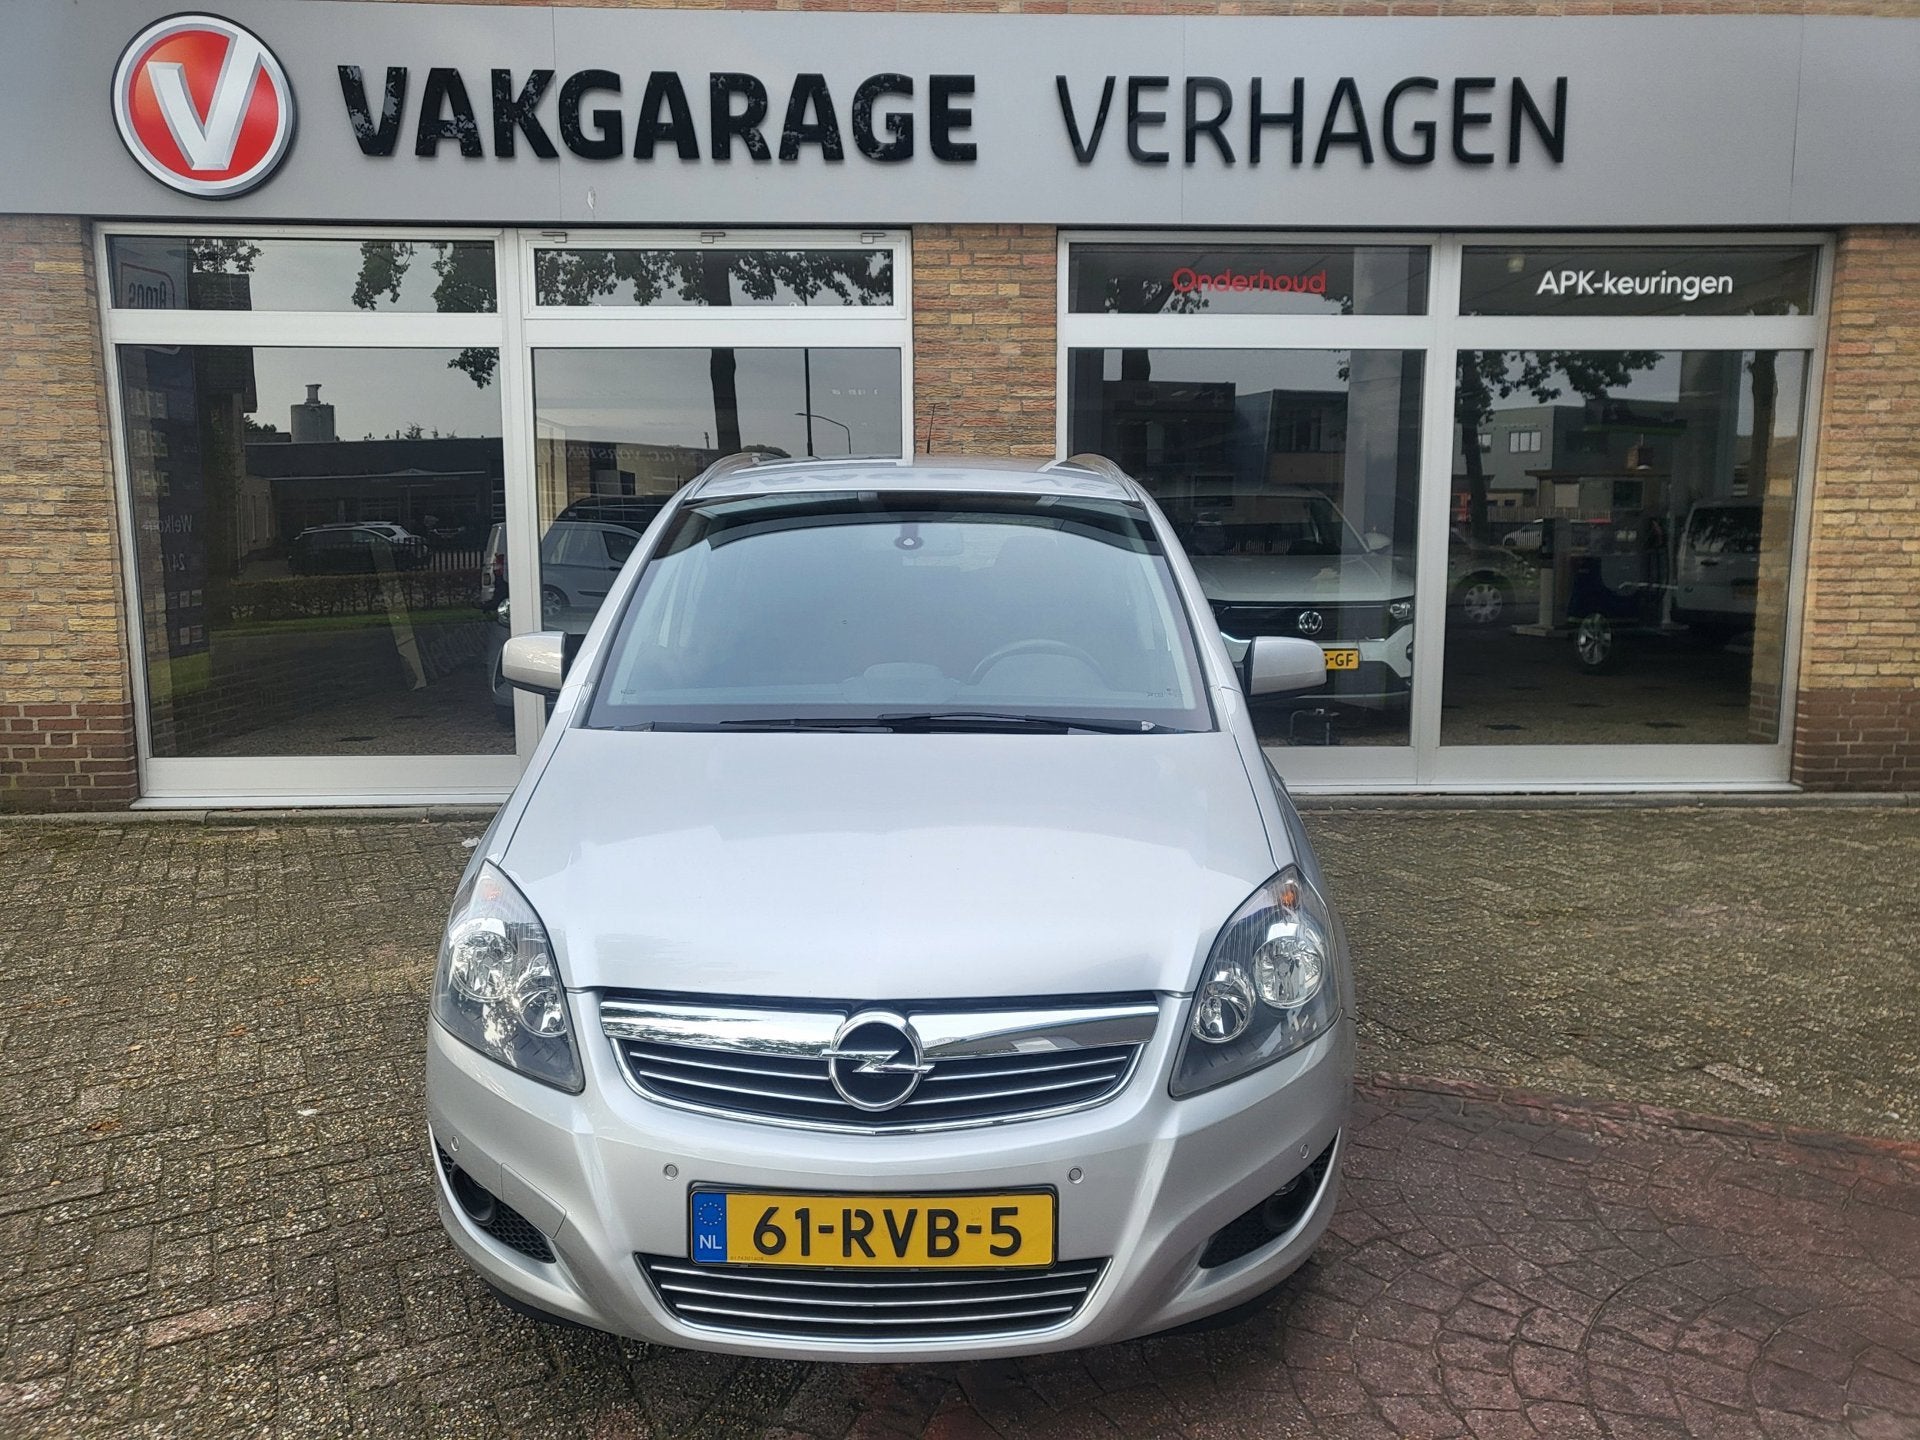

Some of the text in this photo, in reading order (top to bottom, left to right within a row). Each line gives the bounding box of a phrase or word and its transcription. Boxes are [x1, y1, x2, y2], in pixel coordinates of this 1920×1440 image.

[338, 66, 1568, 169] VAKGARAGE VERHAGEN
[1172, 268, 1327, 293] Onderhoud
[1536, 270, 1733, 301] APK-keuringen
[699, 1206, 1022, 1258] NL 61-RVB-5
